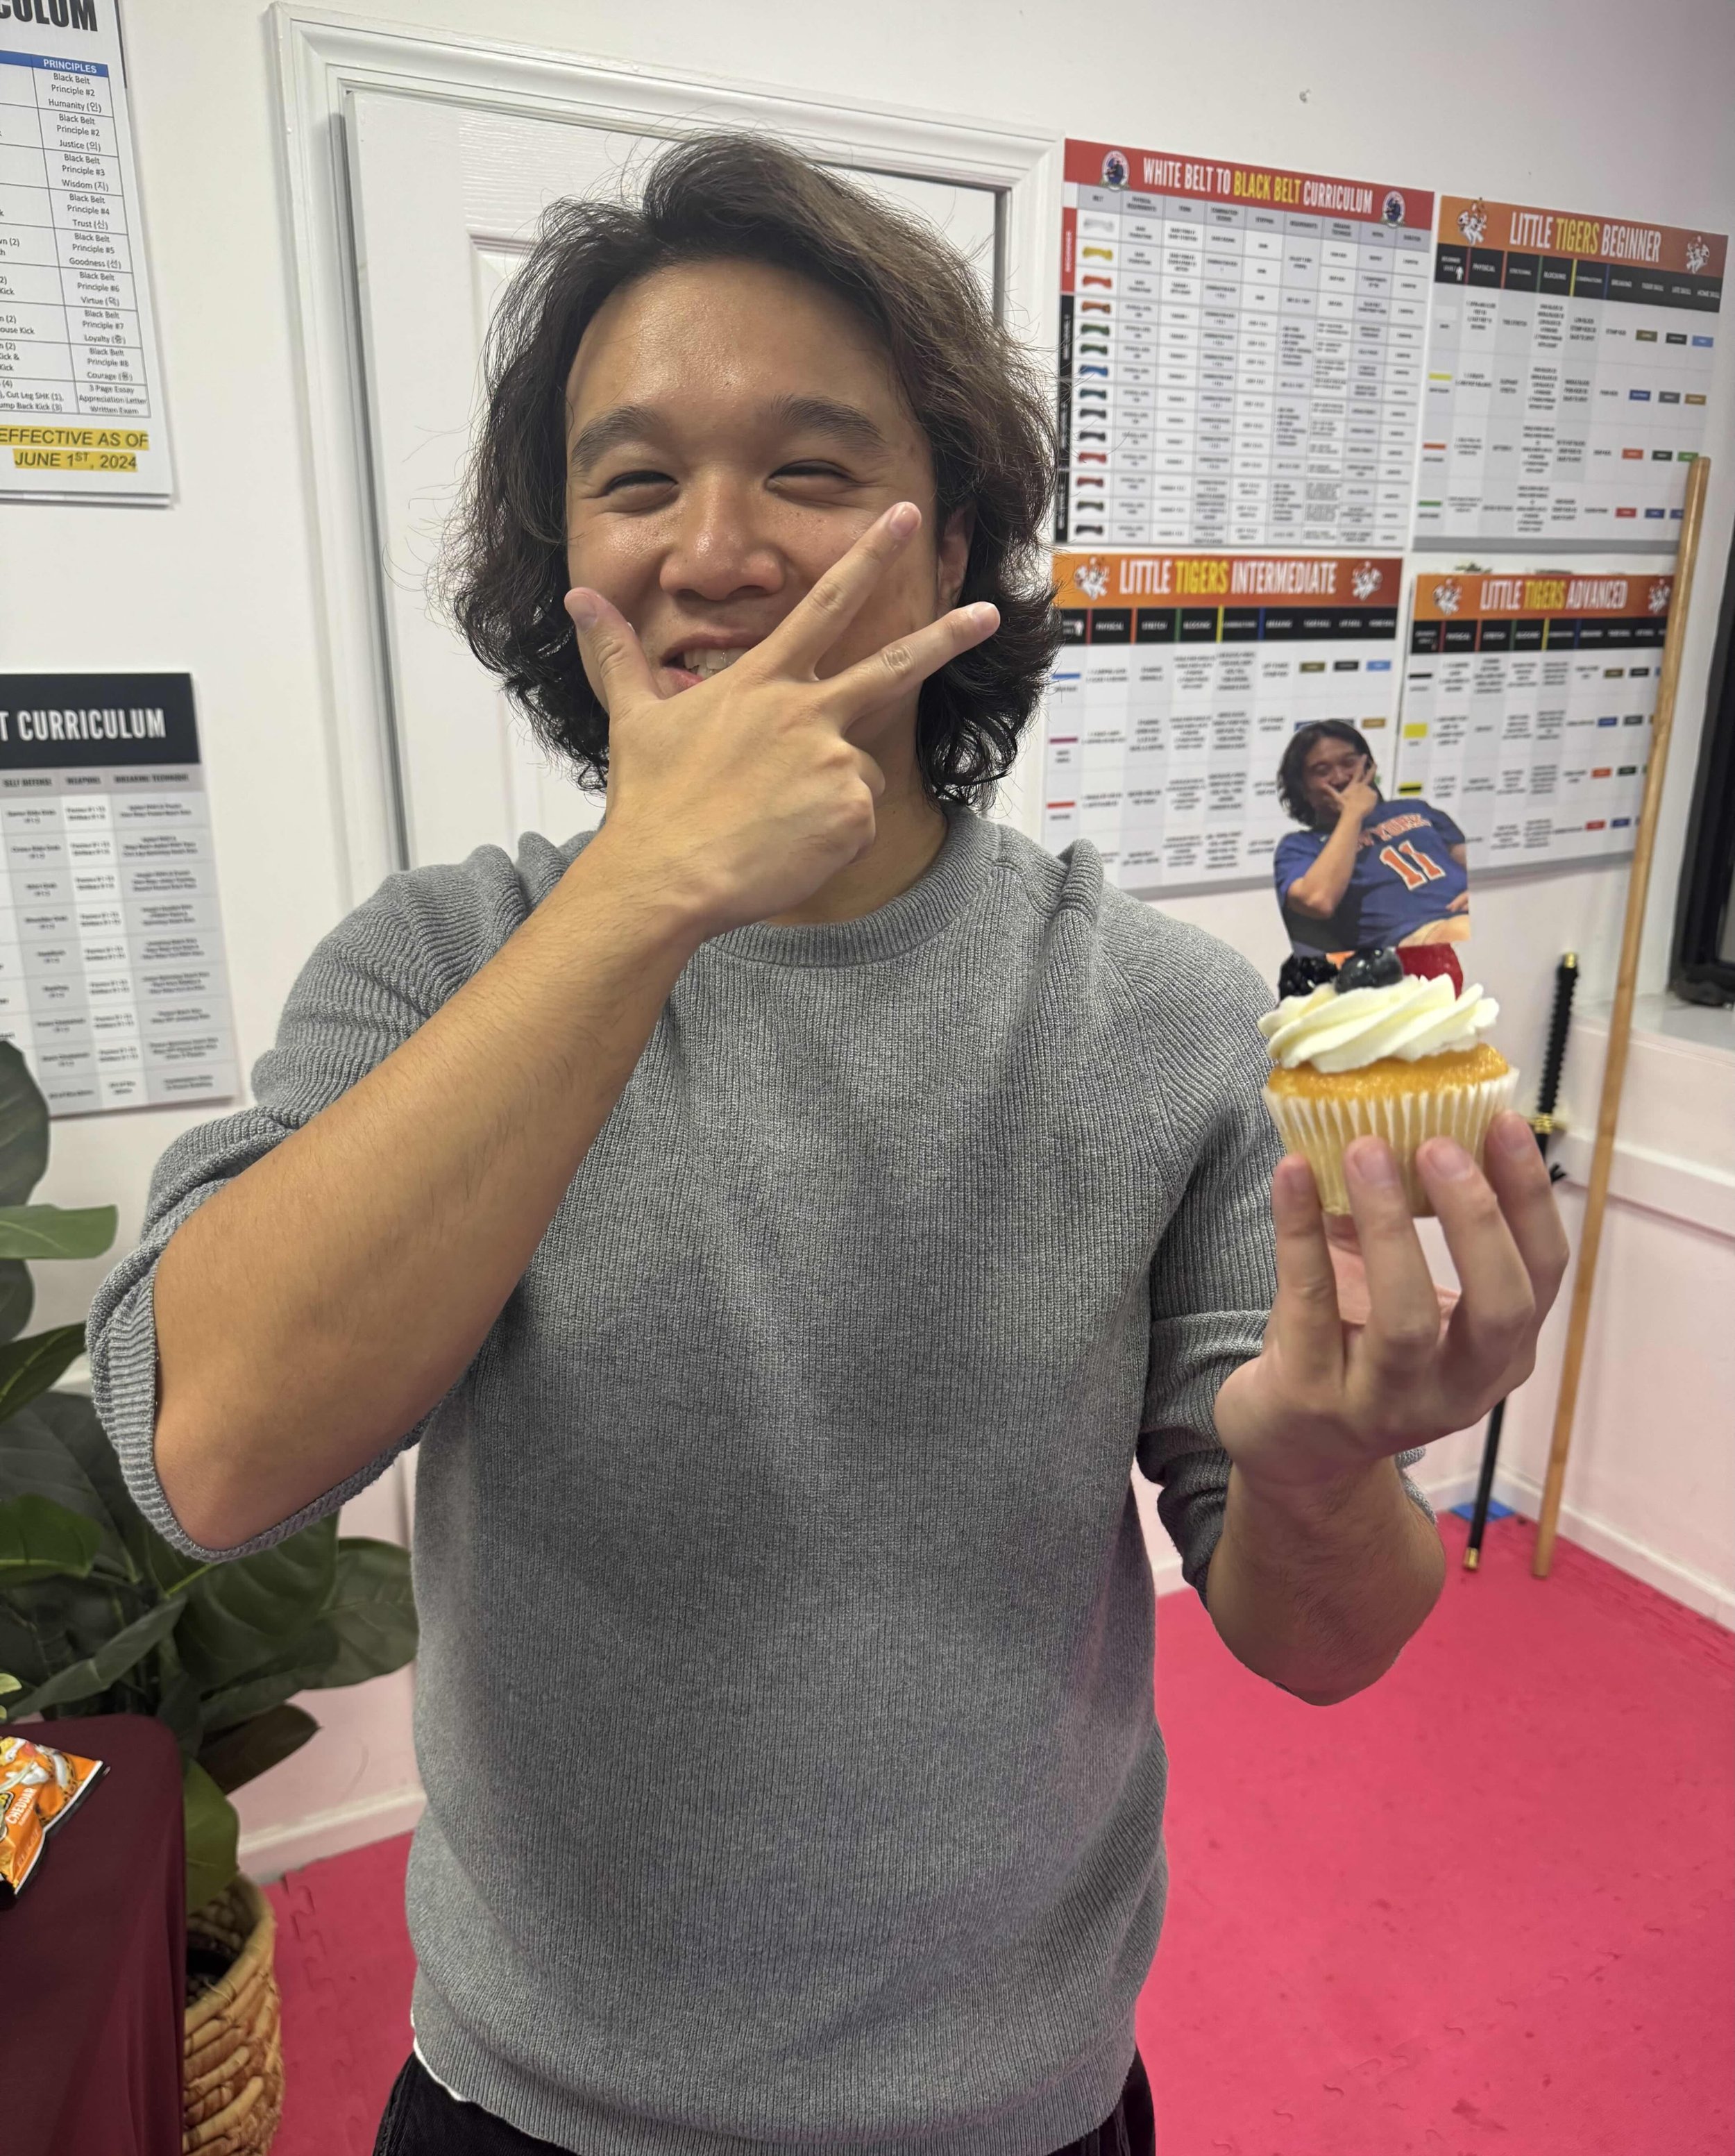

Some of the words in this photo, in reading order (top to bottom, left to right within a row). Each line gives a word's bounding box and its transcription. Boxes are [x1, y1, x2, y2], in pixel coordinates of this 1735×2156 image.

[43, 58, 97, 74] PRINCIPLES
[53, 72, 74, 83] Black
[75, 76, 90, 85] Belt
[51, 84, 84, 95] Principle
[49, 99, 85, 111] Humanity
[59, 113, 78, 124] Black
[81, 117, 95, 125] Belt
[57, 125, 89, 135] Principle
[60, 140, 84, 149] Justice
[64, 153, 83, 162] Black
[85, 156, 100, 165] Belt
[62, 165, 94, 176] Principle
[62, 179, 93, 190] Wisdom
[1144, 158, 1181, 189] WHITE
[1184, 163, 1214, 192] BELT
[1216, 167, 1231, 195] TO
[1233, 171, 1271, 201] BLACK
[1273, 176, 1302, 204] BELT
[1303, 180, 1373, 214] CURRICULUM
[69, 193, 89, 203] Black
[90, 196, 105, 204] Belt
[67, 204, 99, 215] Principle
[72, 219, 92, 228] Trust
[9, 237, 20, 247] (2)
[74, 233, 94, 242] Black
[96, 235, 110, 243] Belt
[1509, 211, 1552, 249] LITTLE
[1555, 217, 1600, 255] TIGERS
[1601, 224, 1661, 263] BEGINNER
[72, 244, 104, 254] Principle
[69, 258, 105, 268] Goodness
[80, 271, 99, 280] Black
[100, 273, 115, 281] Belt
[77, 283, 109, 292] Principle
[81, 296, 103, 305] Virtue
[6, 314, 16, 324] (2)
[85, 310, 103, 318] Black
[83, 320, 113, 330] Principle
[84, 335, 110, 344] Loyalty
[5, 342, 16, 351] (2)
[87, 371, 117, 382] Courage
[0, 428, 93, 446] EFFECTIVE
[97, 432, 121, 446] AS
[125, 433, 149, 448] OF
[15, 452, 61, 467] JUNE
[100, 455, 137, 469] 2024
[1119, 559, 1172, 595] LITTLE
[1175, 559, 1229, 595] TIGERS
[1231, 560, 1338, 596] INTERMEDIATE
[1480, 580, 1523, 611] LITTLE
[1523, 580, 1566, 610] TIGERS
[1566, 580, 1628, 609] ADVANCED
[17, 708, 167, 741] CURRICULUM
[1380, 840, 1446, 891] 11
